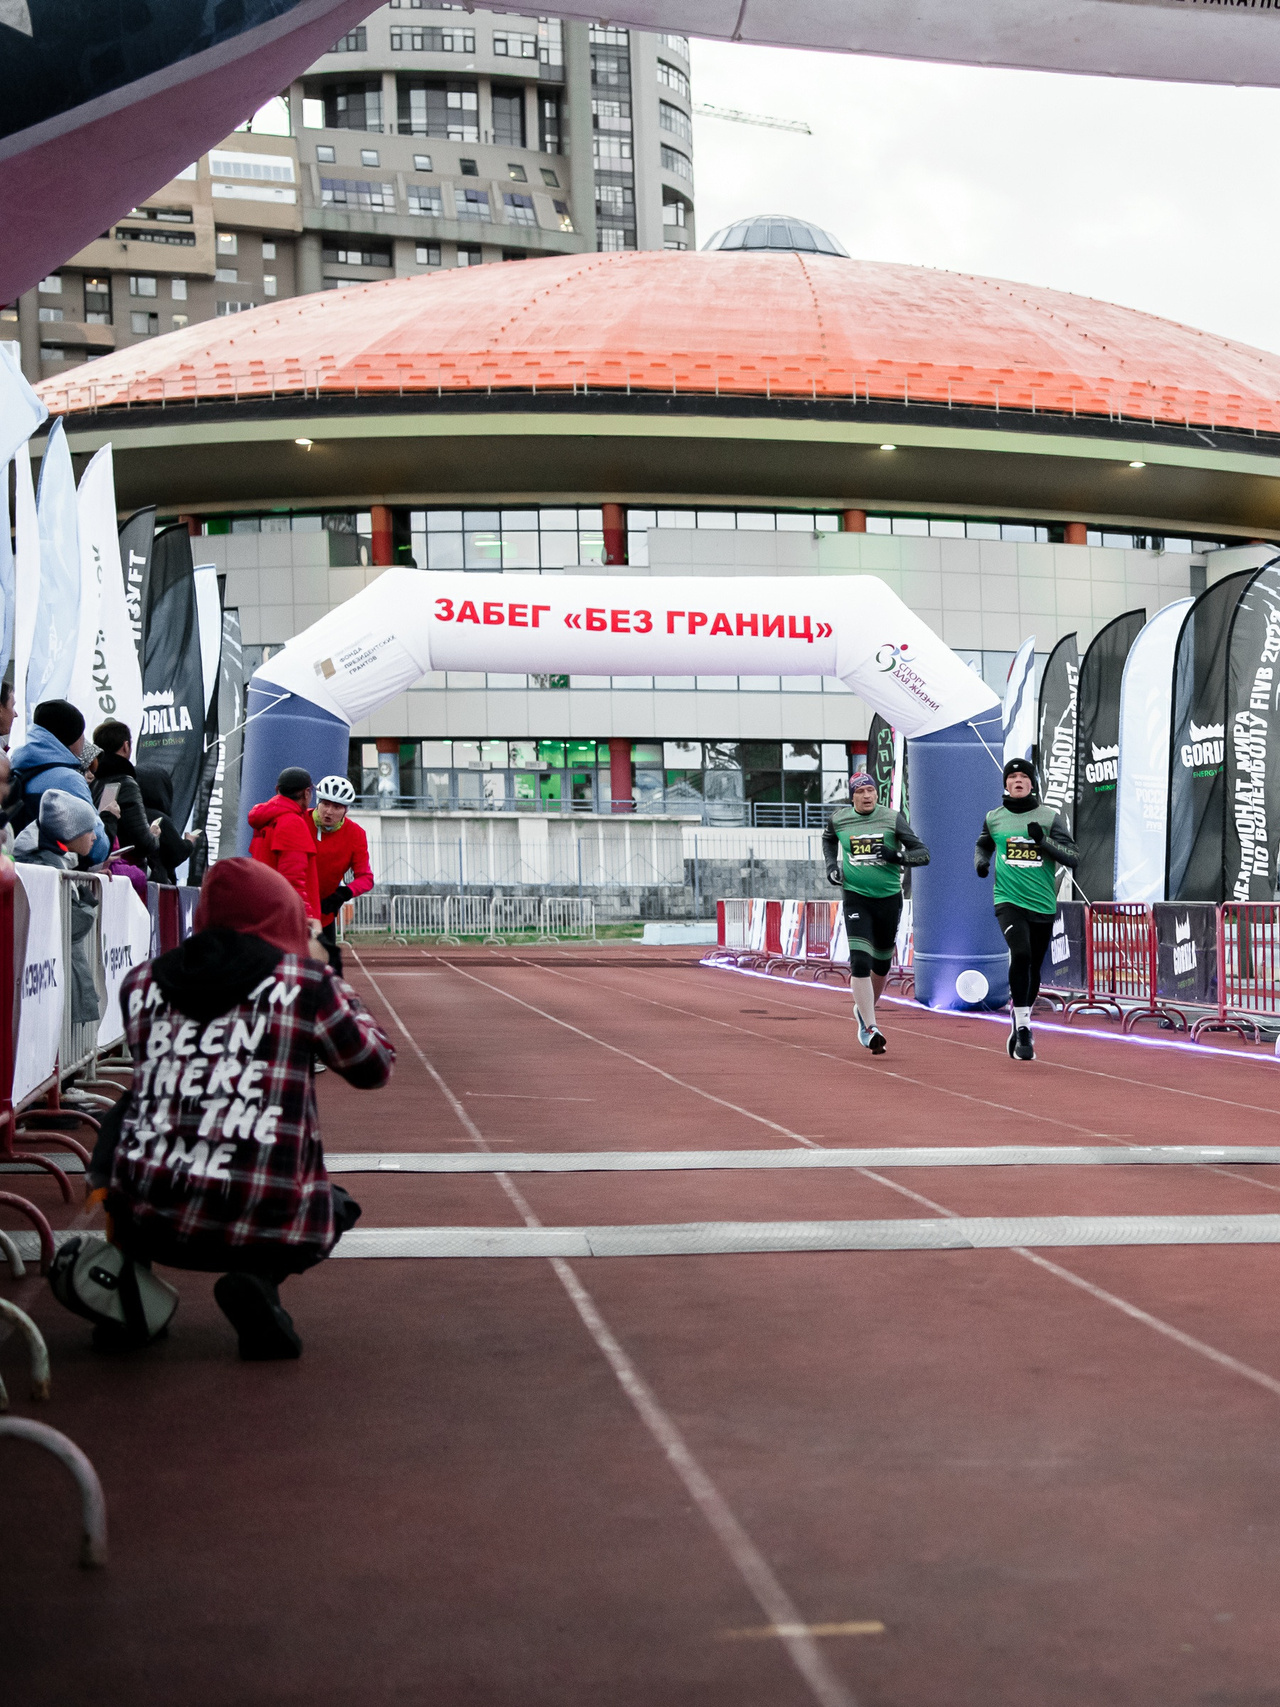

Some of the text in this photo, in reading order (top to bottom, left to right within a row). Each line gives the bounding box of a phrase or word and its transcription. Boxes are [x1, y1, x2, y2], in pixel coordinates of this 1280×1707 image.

[434, 598, 834, 643] ЗАБЕГ «БЕЗ ГРАНИЦ»
[339, 647, 363, 663] ФОНДА
[344, 634, 397, 669] ПРЕЗИДЕНТСКИХ
[348, 655, 378, 675] ГРАНТОВ
[892, 669, 911, 685] ДЛЯ
[909, 683, 940, 712] ЖИЗНИ
[899, 662, 927, 688] СПОРТ
[1250, 667, 1274, 711] FIVB
[1043, 726, 1074, 815] ЛЕЙБОЛ
[1248, 718, 1269, 844] ВОЛЕЙБОЛУ
[1233, 710, 1257, 902] ЧЕМПИОНАТ МИРА
[1007, 848, 1038, 860] 2249
[1252, 845, 1269, 877] ПО
[147, 1014, 267, 1060] BEEN
[138, 1056, 269, 1100] THERE
[198, 1098, 284, 1145] THE
